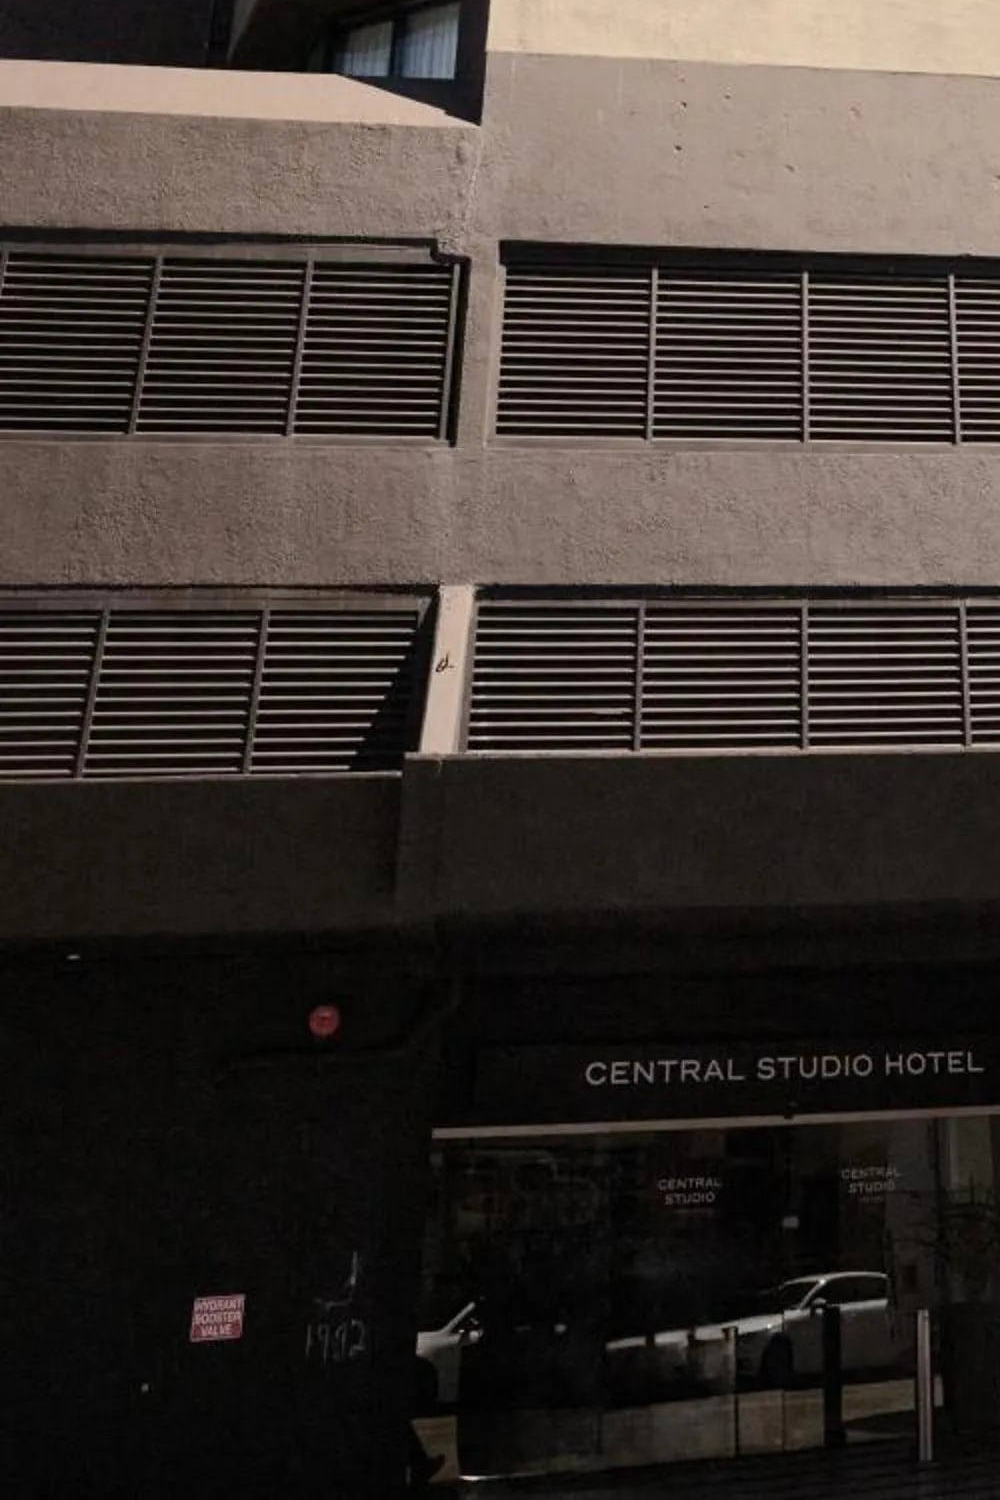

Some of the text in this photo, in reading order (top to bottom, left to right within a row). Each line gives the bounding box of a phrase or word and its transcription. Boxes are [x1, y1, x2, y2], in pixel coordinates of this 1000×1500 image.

[585, 1050, 984, 1085] CENTRAL STUDIO HOTEL
[842, 1167, 902, 1180] CENTRAL
[657, 1177, 722, 1191] CENTRAL
[849, 1181, 896, 1194] STUDIO
[664, 1191, 717, 1206] STUDIO
